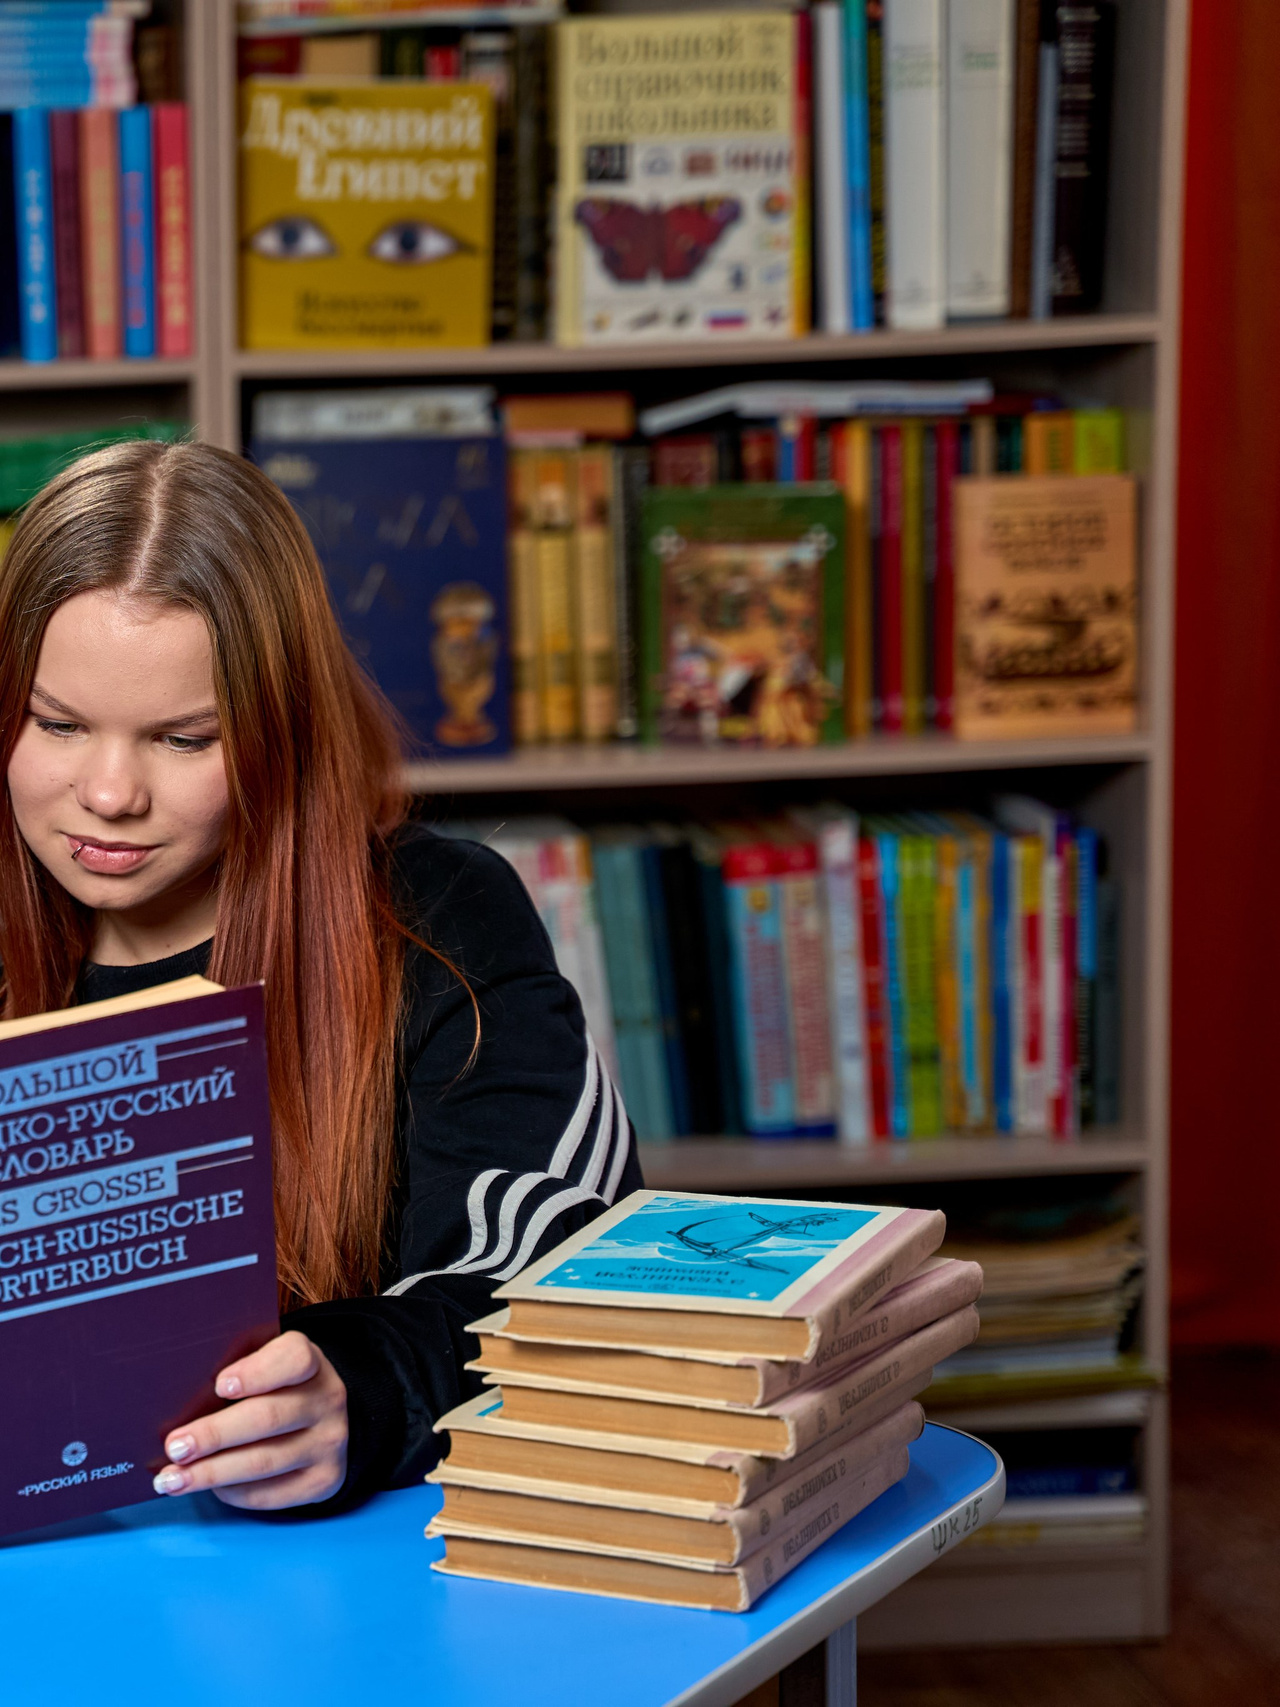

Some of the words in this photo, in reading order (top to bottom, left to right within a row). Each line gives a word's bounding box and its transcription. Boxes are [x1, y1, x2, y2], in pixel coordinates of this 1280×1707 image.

[242, 93, 483, 158] Древний
[296, 148, 486, 200] Египет
[32, 1166, 166, 1217] GROSSE
[595, 1271, 727, 1284] ХЕМИНГУЭЙ
[816, 1319, 879, 1368] ХЕМИНГУЭЙ
[838, 1366, 892, 1416] ХЕМИНГУЭЙ
[782, 1463, 838, 1516] ХЕМИНГУЭЙ
[963, 1497, 983, 1532] 25
[783, 1508, 832, 1562] ХЕМИНГУЭЙ
